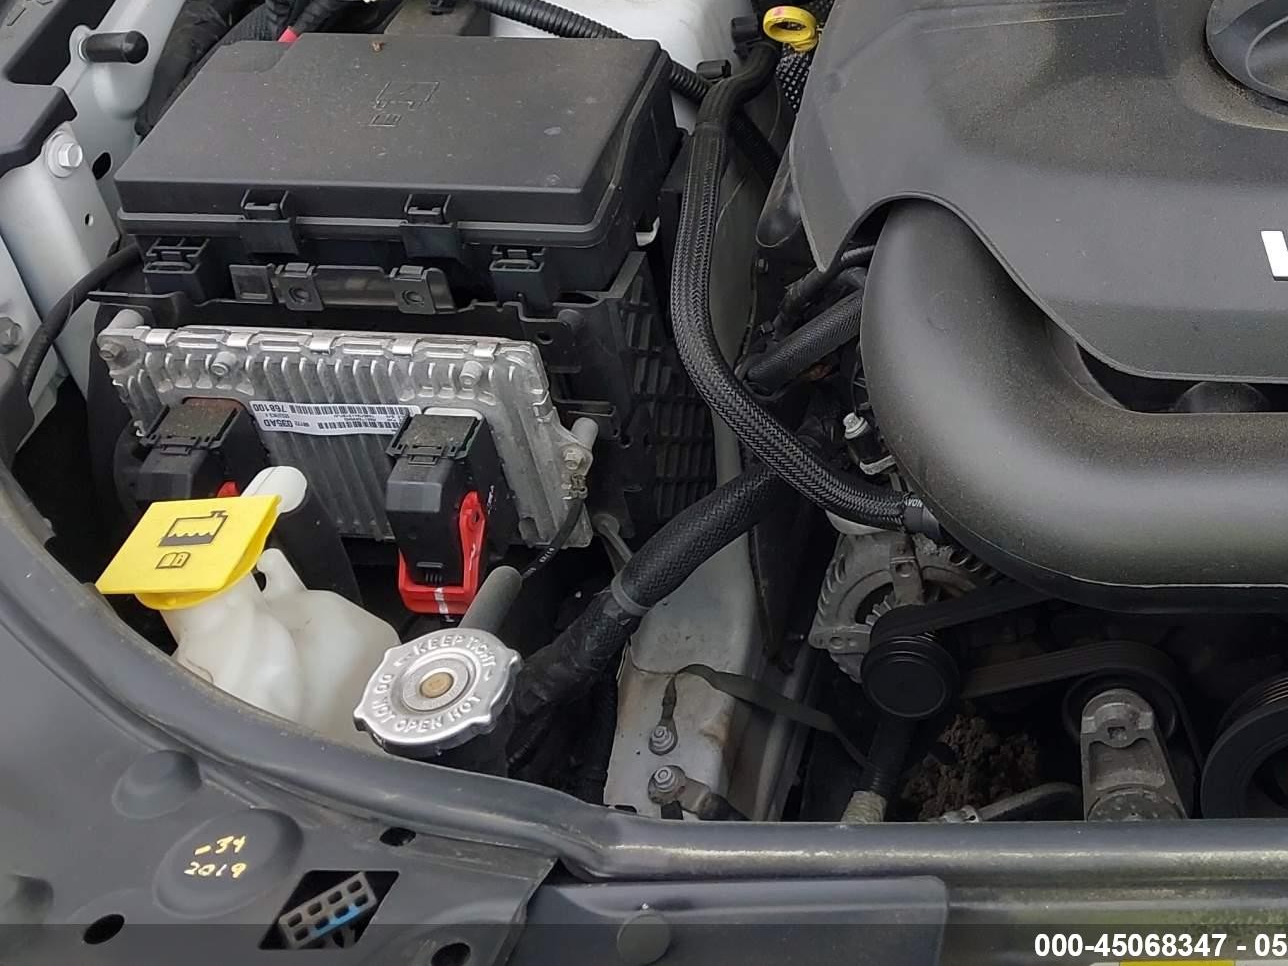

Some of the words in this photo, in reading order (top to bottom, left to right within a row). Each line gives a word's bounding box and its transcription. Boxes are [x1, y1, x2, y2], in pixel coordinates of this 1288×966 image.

[413, 634, 465, 656] KEEP
[394, 716, 445, 733] OPEN
[449, 693, 482, 722] HOT
[184, 861, 247, 879] 2019
